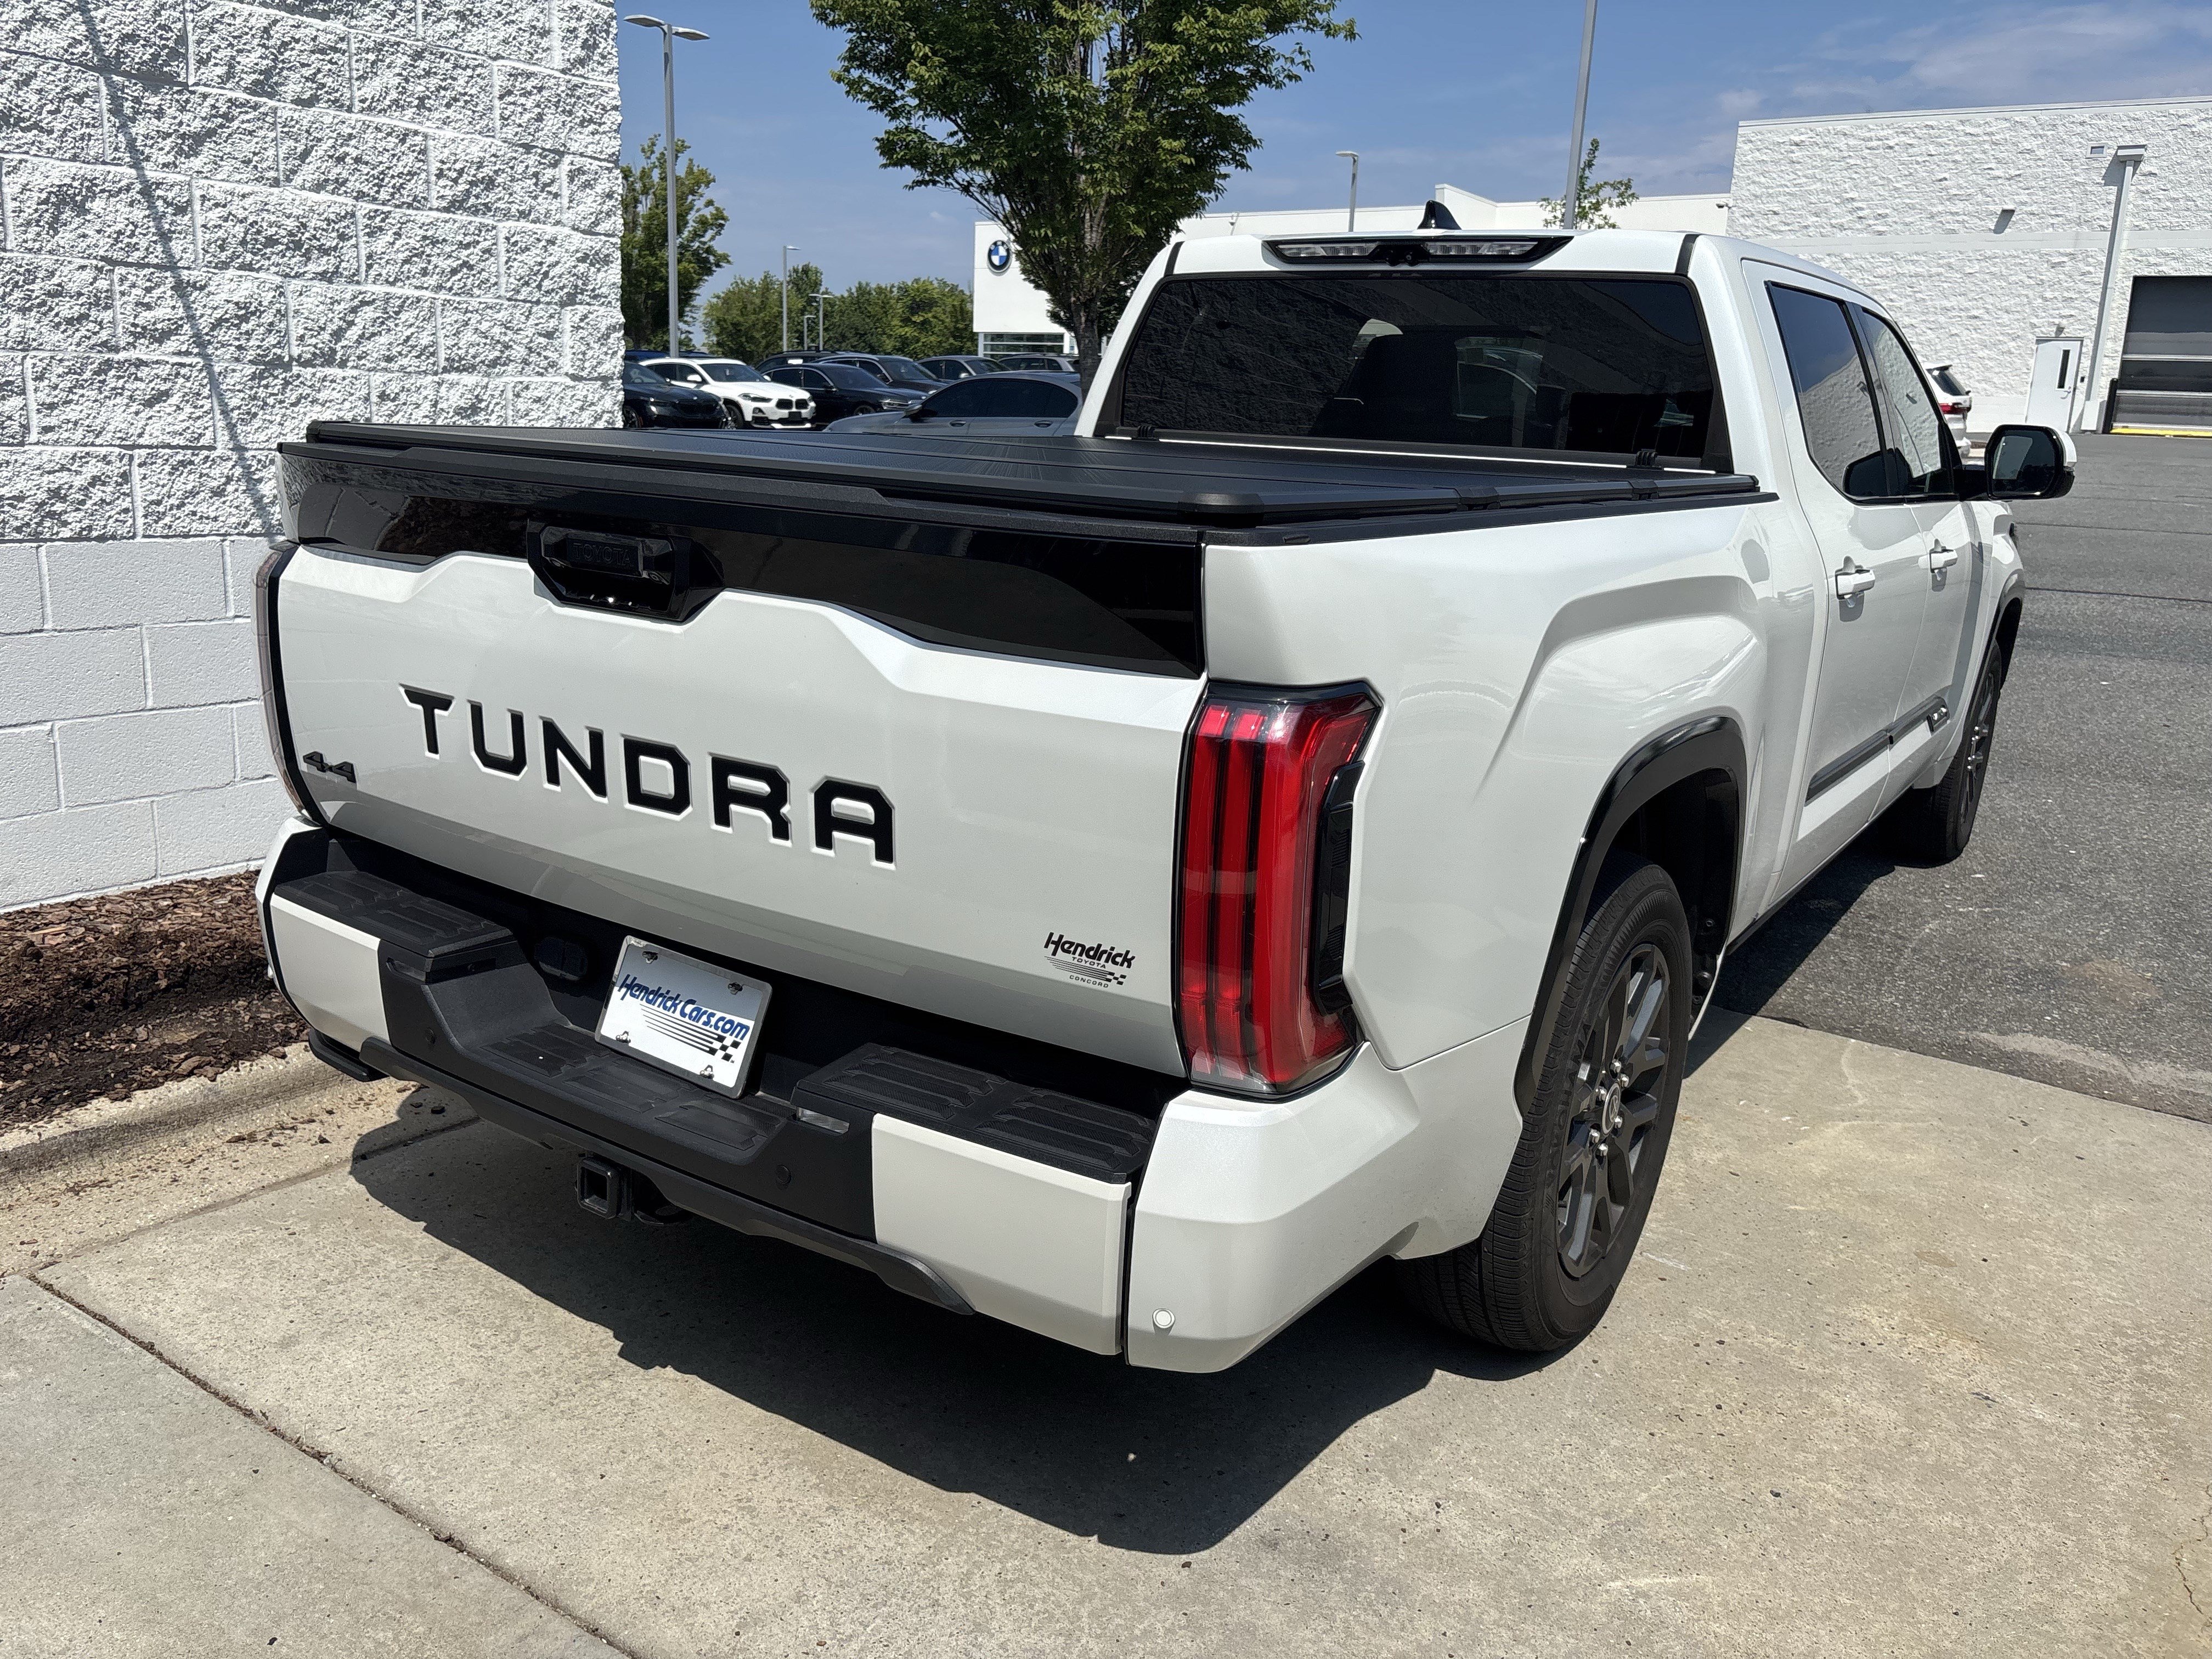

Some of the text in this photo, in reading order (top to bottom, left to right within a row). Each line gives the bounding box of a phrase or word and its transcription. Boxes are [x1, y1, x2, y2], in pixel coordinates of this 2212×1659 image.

[572, 543, 633, 567] TOYOTA
[400, 684, 895, 868] TUNDRA
[1044, 932, 1136, 968] Hendrick
[1072, 957, 1106, 969] TOYOTA
[1069, 975, 1109, 988] CONCORD
[1546, 1023, 1592, 1187] YOKOHAMA
